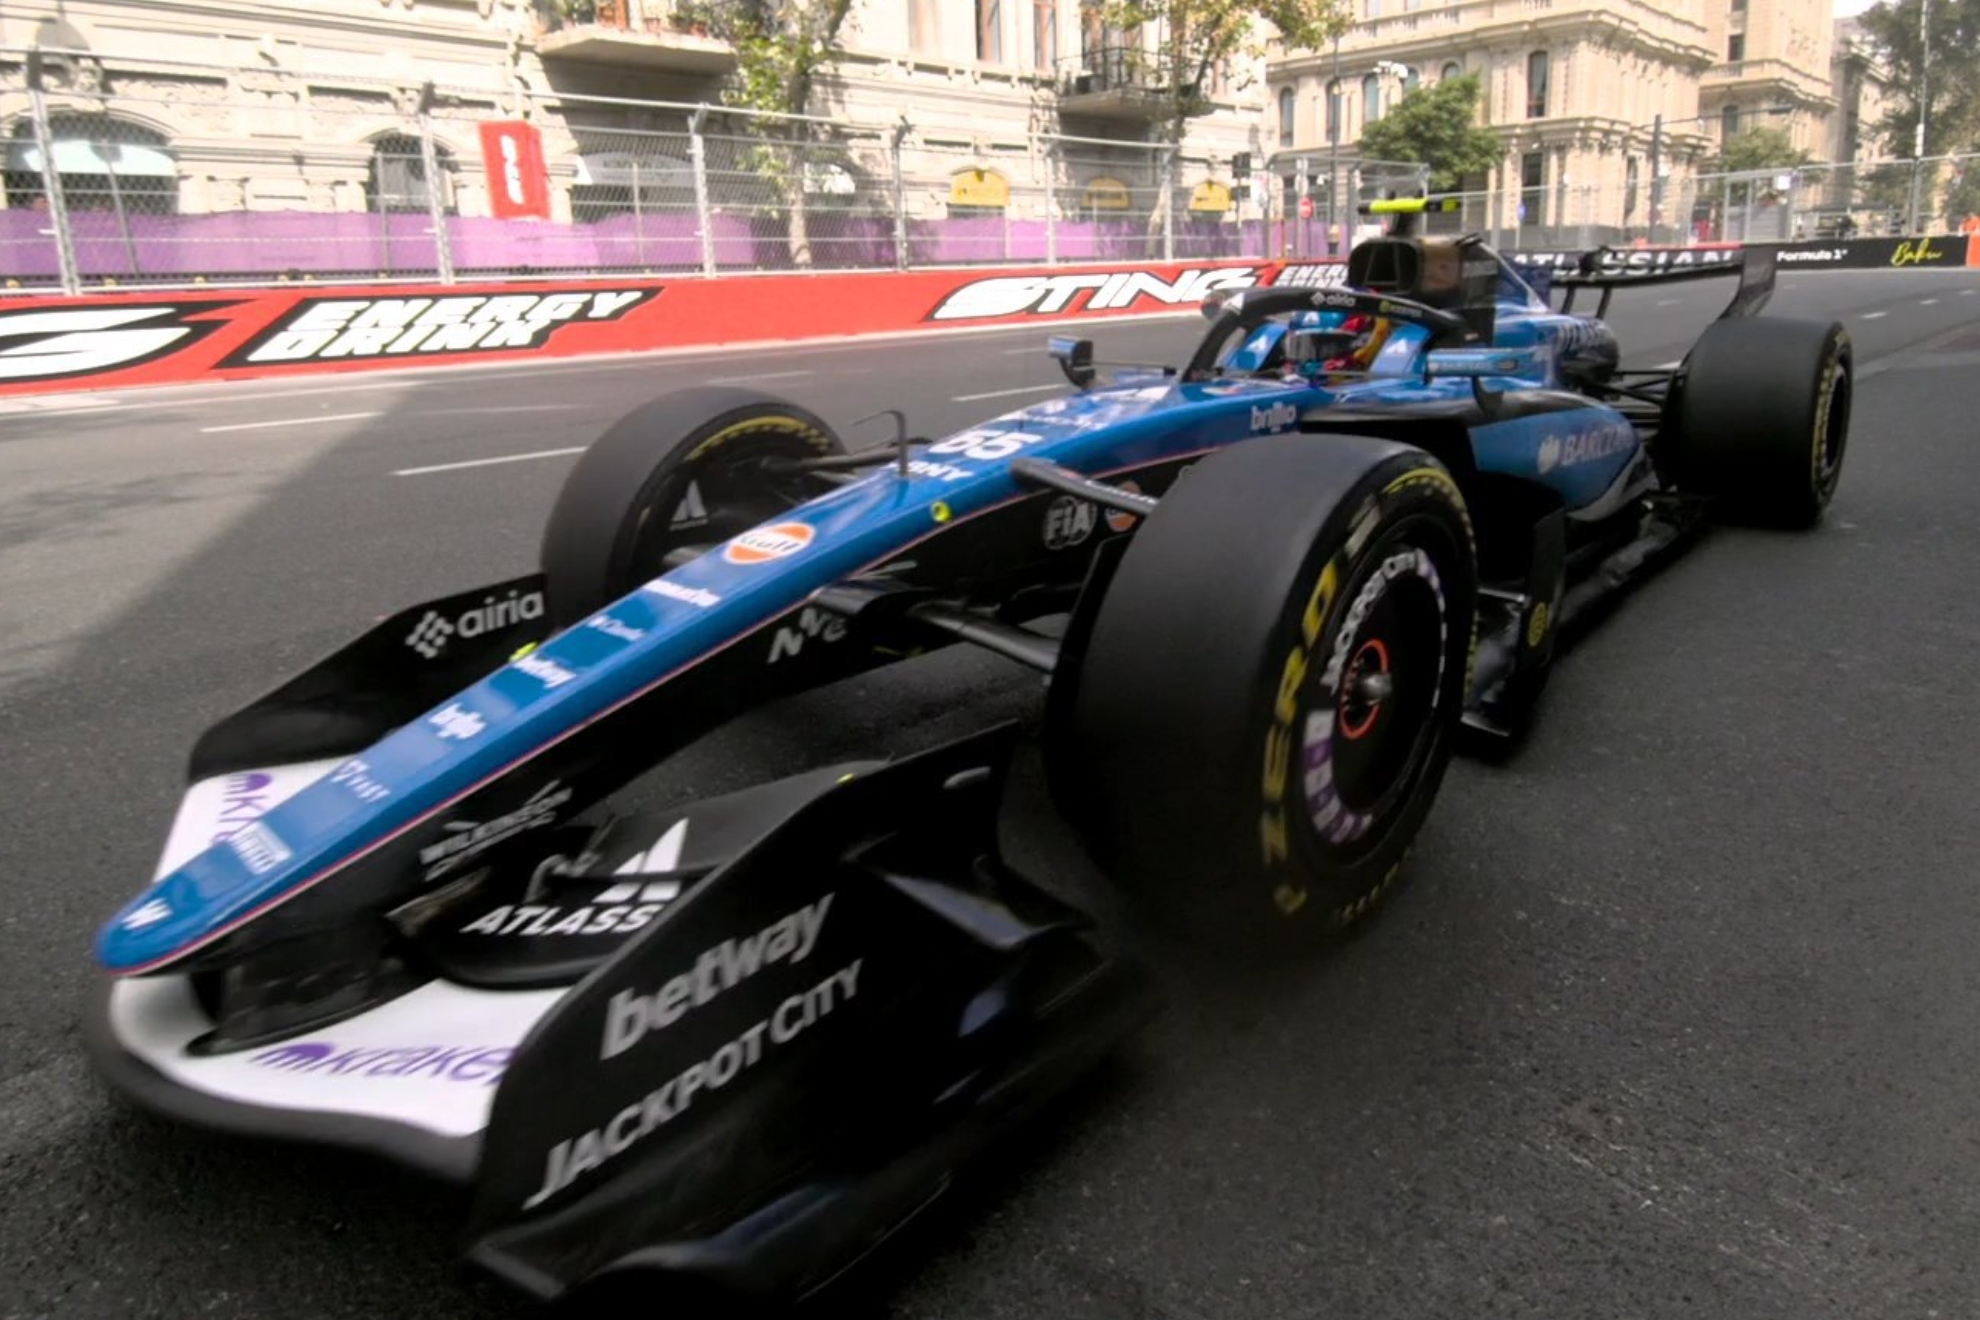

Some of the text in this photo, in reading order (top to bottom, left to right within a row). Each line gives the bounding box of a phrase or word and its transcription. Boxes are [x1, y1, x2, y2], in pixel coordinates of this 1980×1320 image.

[1513, 251, 1734, 275] ATLSSIAN
[1776, 249, 1833, 263] Formula
[287, 290, 642, 332] ENERGY
[933, 269, 1258, 320] STING
[246, 321, 553, 362] DRINK
[458, 590, 545, 640] airia
[460, 905, 666, 936] ATLASS
[600, 892, 836, 1060] betway
[303, 1045, 518, 1086] krake
[521, 960, 863, 1212] JACKPOT CITY
